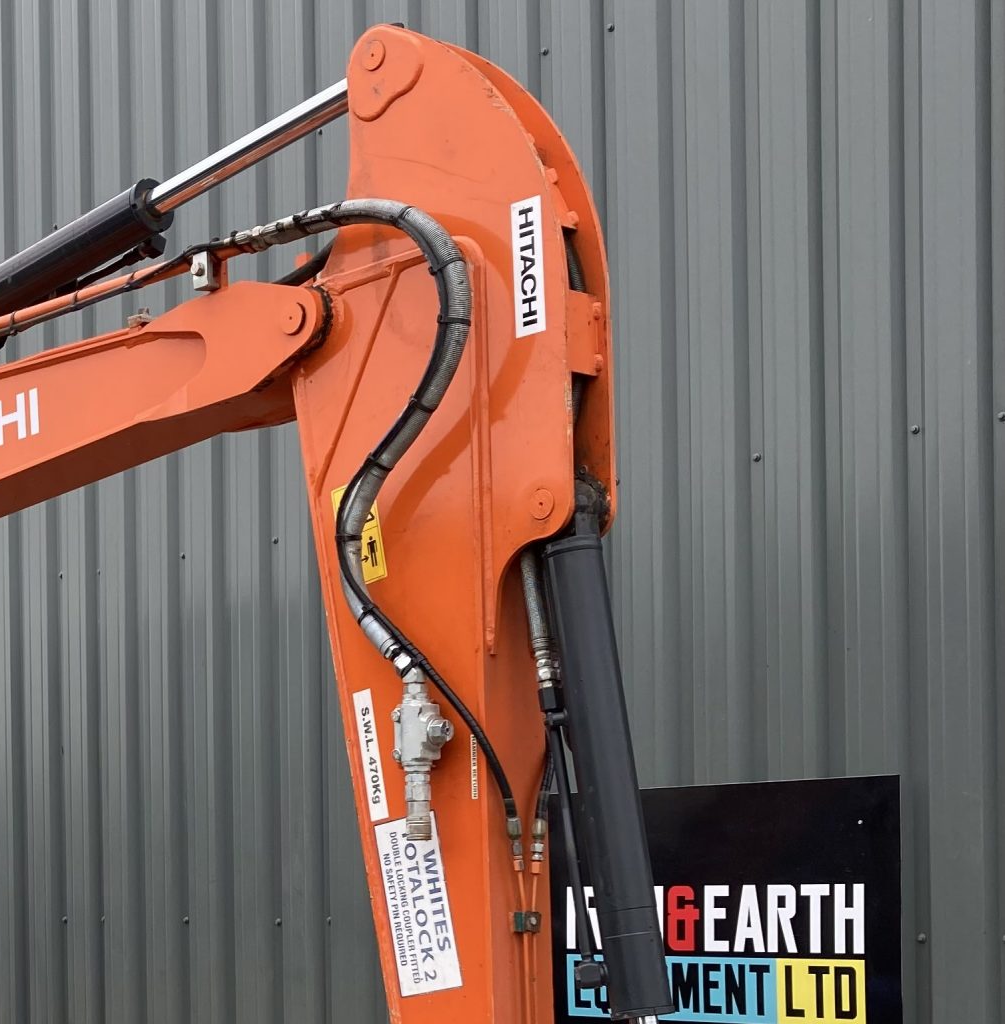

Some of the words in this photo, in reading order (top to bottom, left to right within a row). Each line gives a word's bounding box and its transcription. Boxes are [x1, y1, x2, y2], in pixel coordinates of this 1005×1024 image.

[518, 206, 538, 327] HITACHI
[361, 706, 374, 752] S.W.L.
[382, 853, 392, 866] NO
[389, 831, 402, 867] DOUBLE
[385, 868, 398, 901] SAFETY
[395, 868, 409, 908] LOCKING
[423, 848, 451, 952] WHITES
[391, 903, 400, 920] PIN
[402, 831, 434, 963] OTALOCK
[424, 970, 437, 982] 2
[394, 921, 408, 967] REQUIRED
[402, 909, 416, 952] COUPLER
[409, 953, 421, 984] FITTED
[784, 964, 857, 1021] LTD
